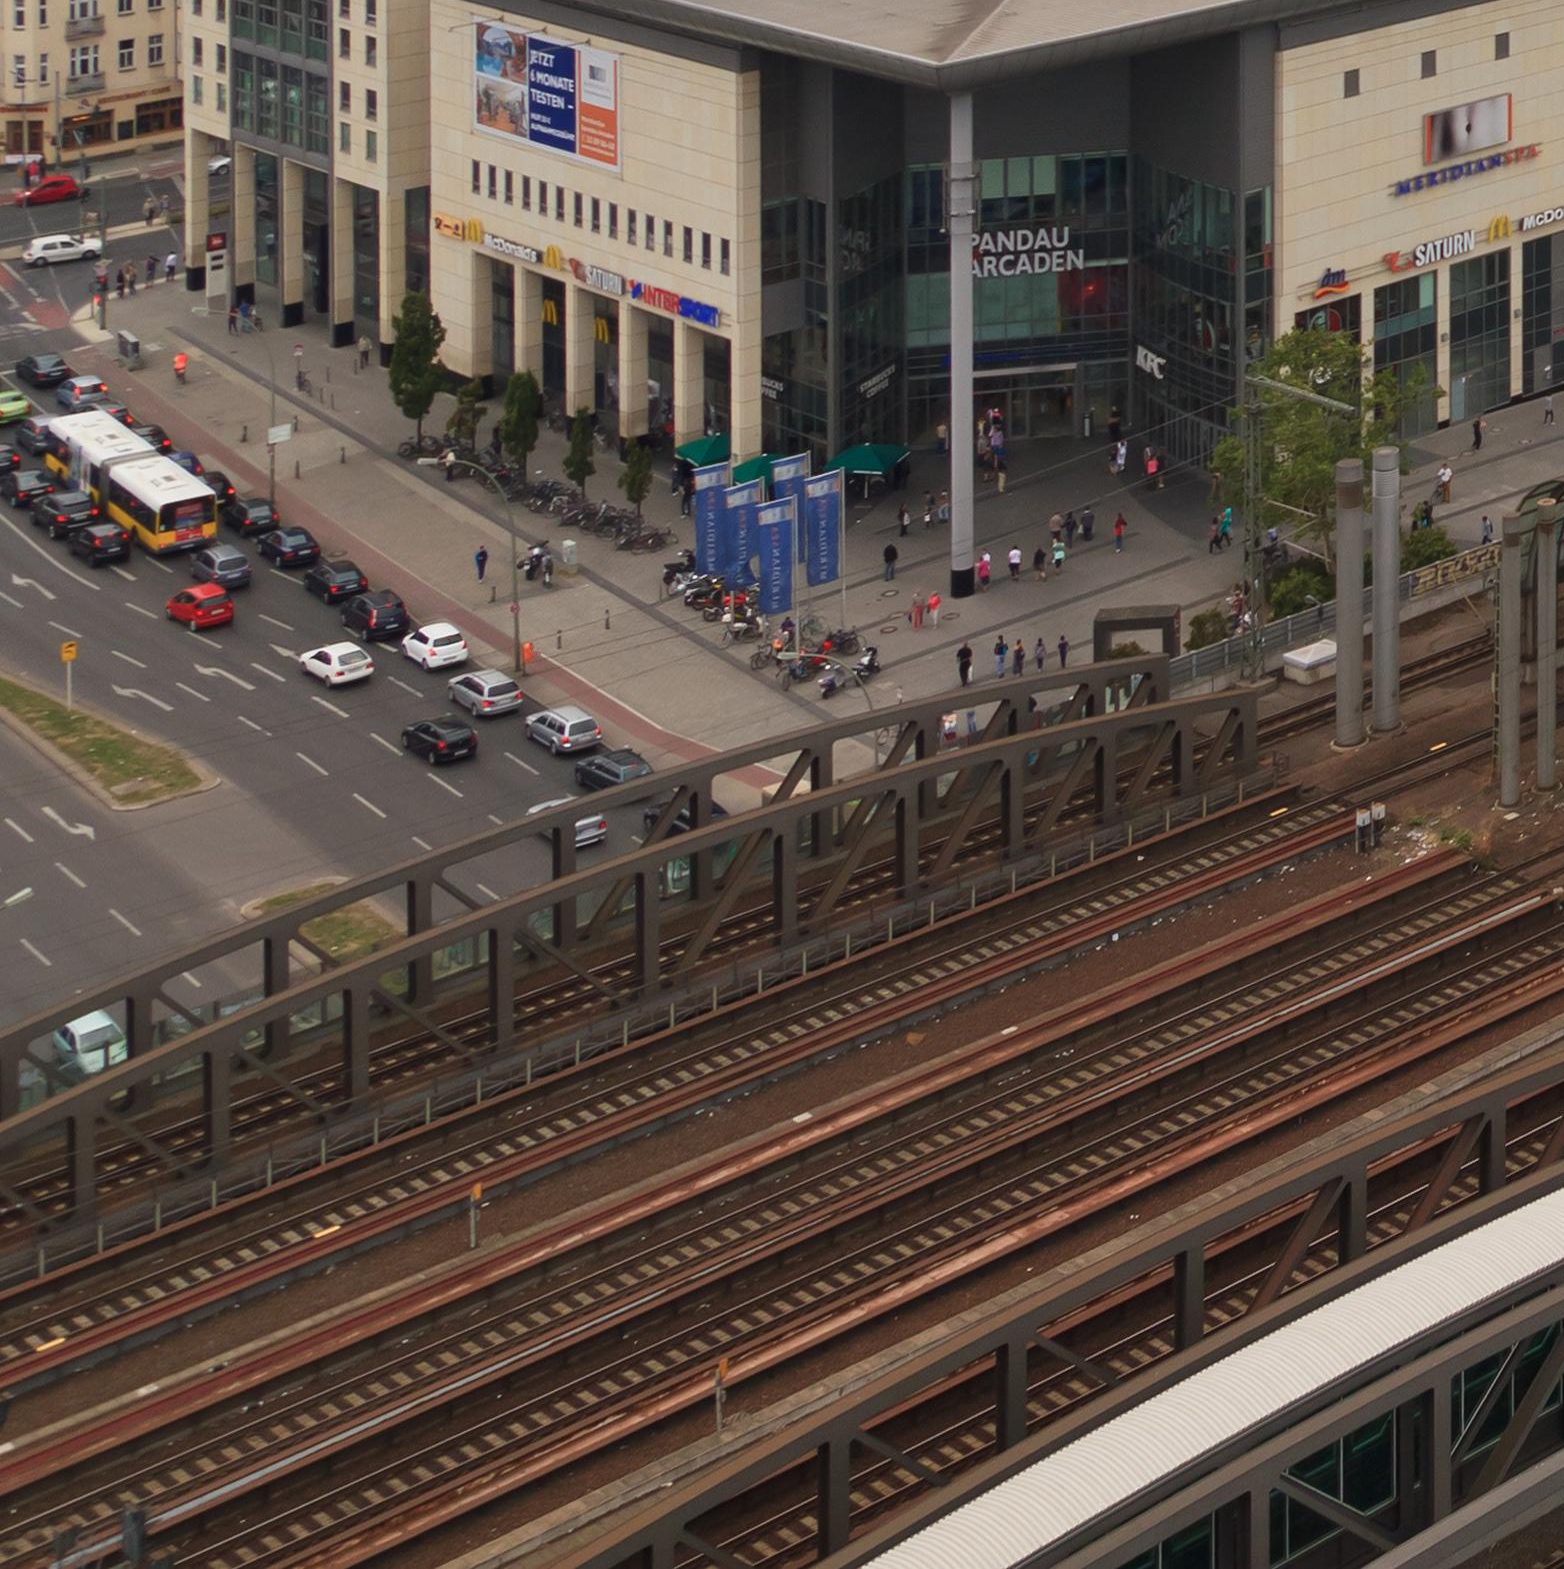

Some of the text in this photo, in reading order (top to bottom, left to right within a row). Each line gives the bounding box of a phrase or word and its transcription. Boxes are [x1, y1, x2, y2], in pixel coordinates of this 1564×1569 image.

[529, 49, 555, 68] JETZT
[536, 72, 575, 93] MONATE
[530, 88, 565, 110] TESTEN
[484, 234, 538, 263] McDonald's
[971, 226, 1070, 254] PANDAU
[1413, 229, 1476, 268] SATURN
[585, 265, 623, 295] SATURN
[1321, 267, 1346, 287] dm
[641, 285, 720, 328] INTERSPORT
[1135, 344, 1167, 380] KFC
